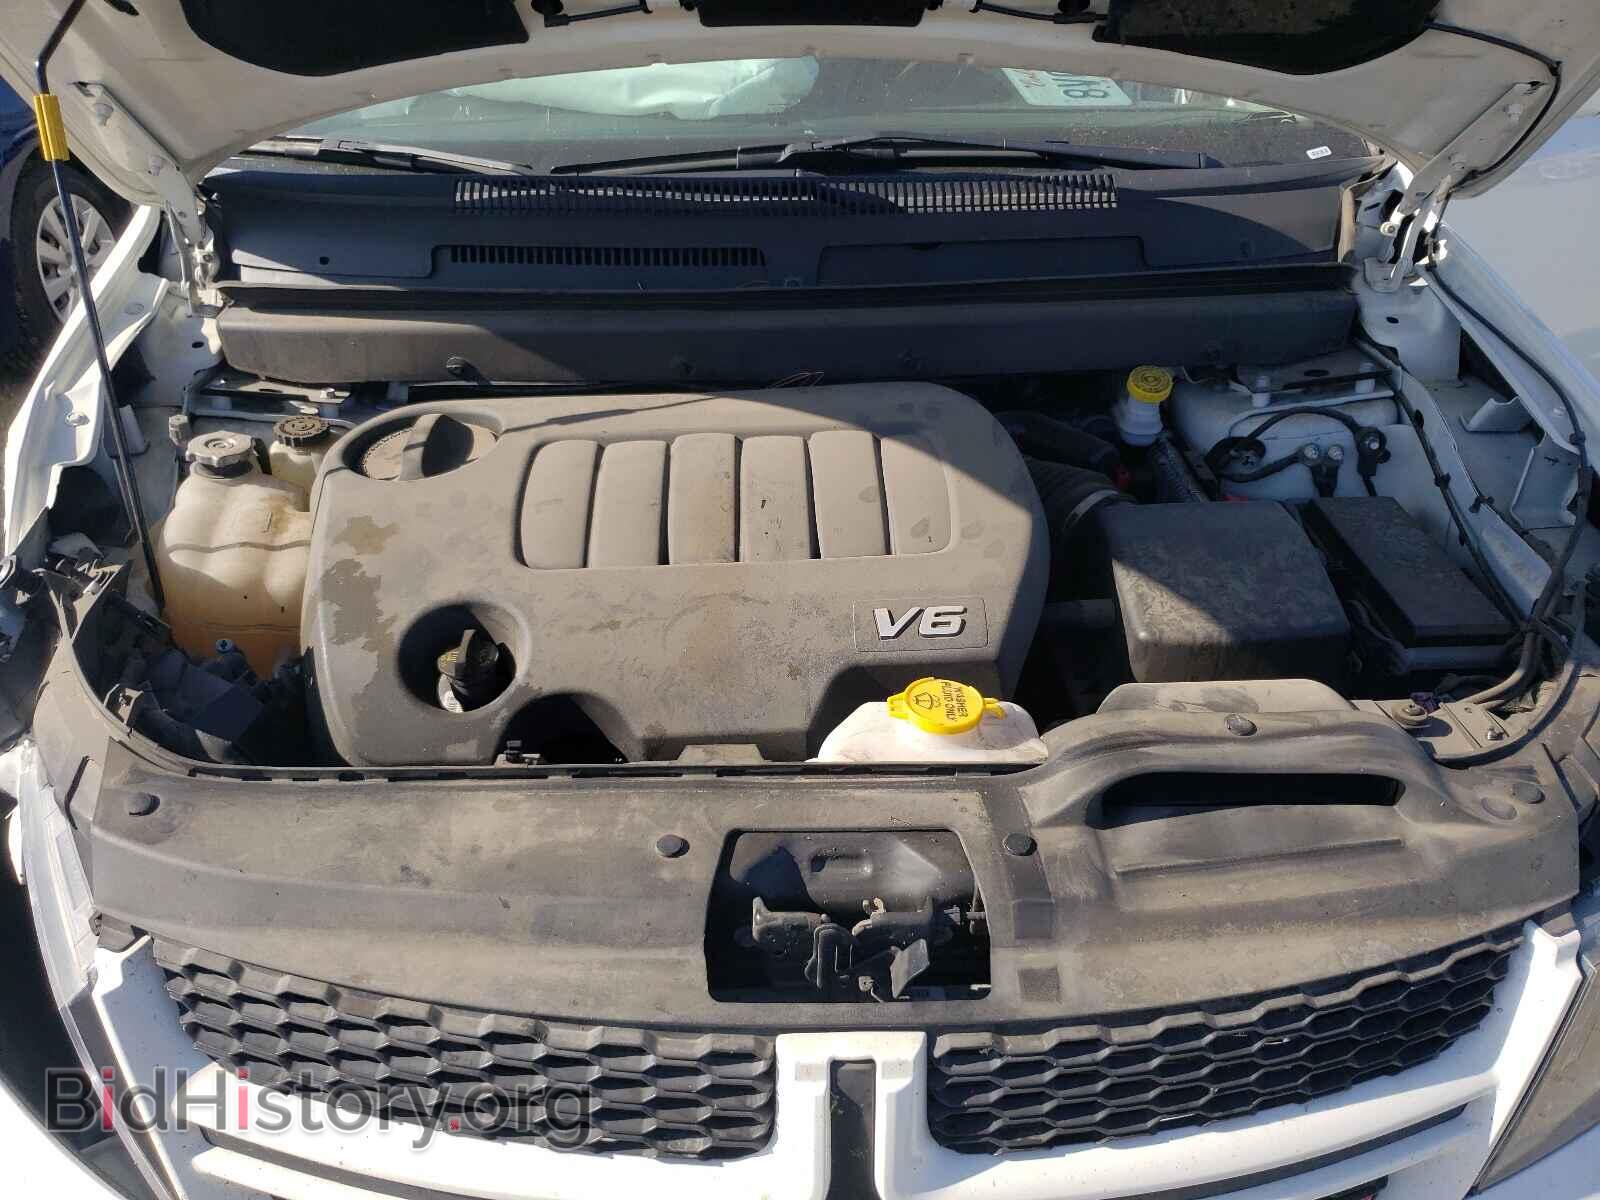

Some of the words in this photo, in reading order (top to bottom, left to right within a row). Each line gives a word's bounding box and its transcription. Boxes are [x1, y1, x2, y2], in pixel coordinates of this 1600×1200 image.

[872, 605, 967, 640] V6
[941, 681, 953, 702] FLUID
[953, 686, 969, 718] WASHER
[944, 703, 957, 722] ONLY
